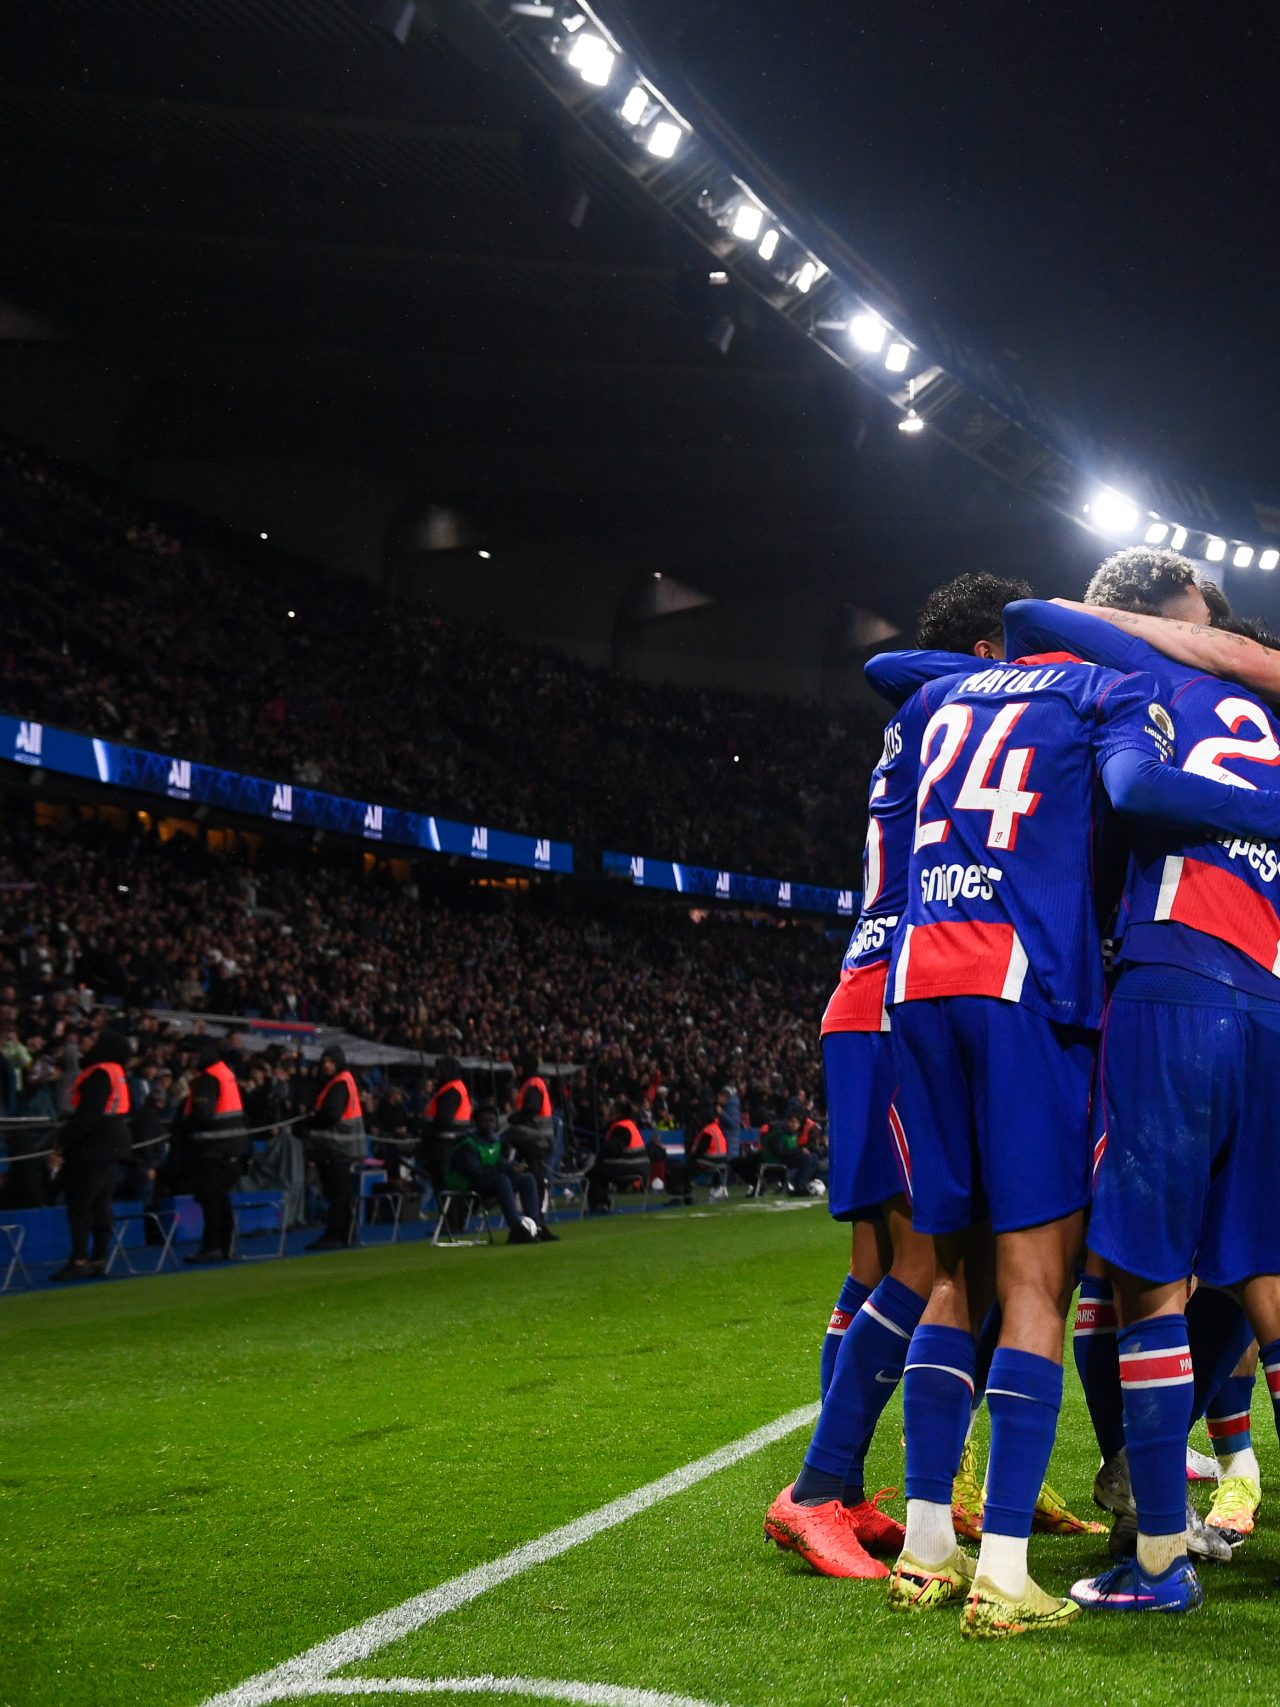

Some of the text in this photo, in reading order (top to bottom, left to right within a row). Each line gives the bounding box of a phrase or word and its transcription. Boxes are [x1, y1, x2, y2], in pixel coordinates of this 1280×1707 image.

[957, 668, 1066, 694] MAYULU
[913, 701, 1043, 855] 24
[920, 863, 1003, 907] snipes
